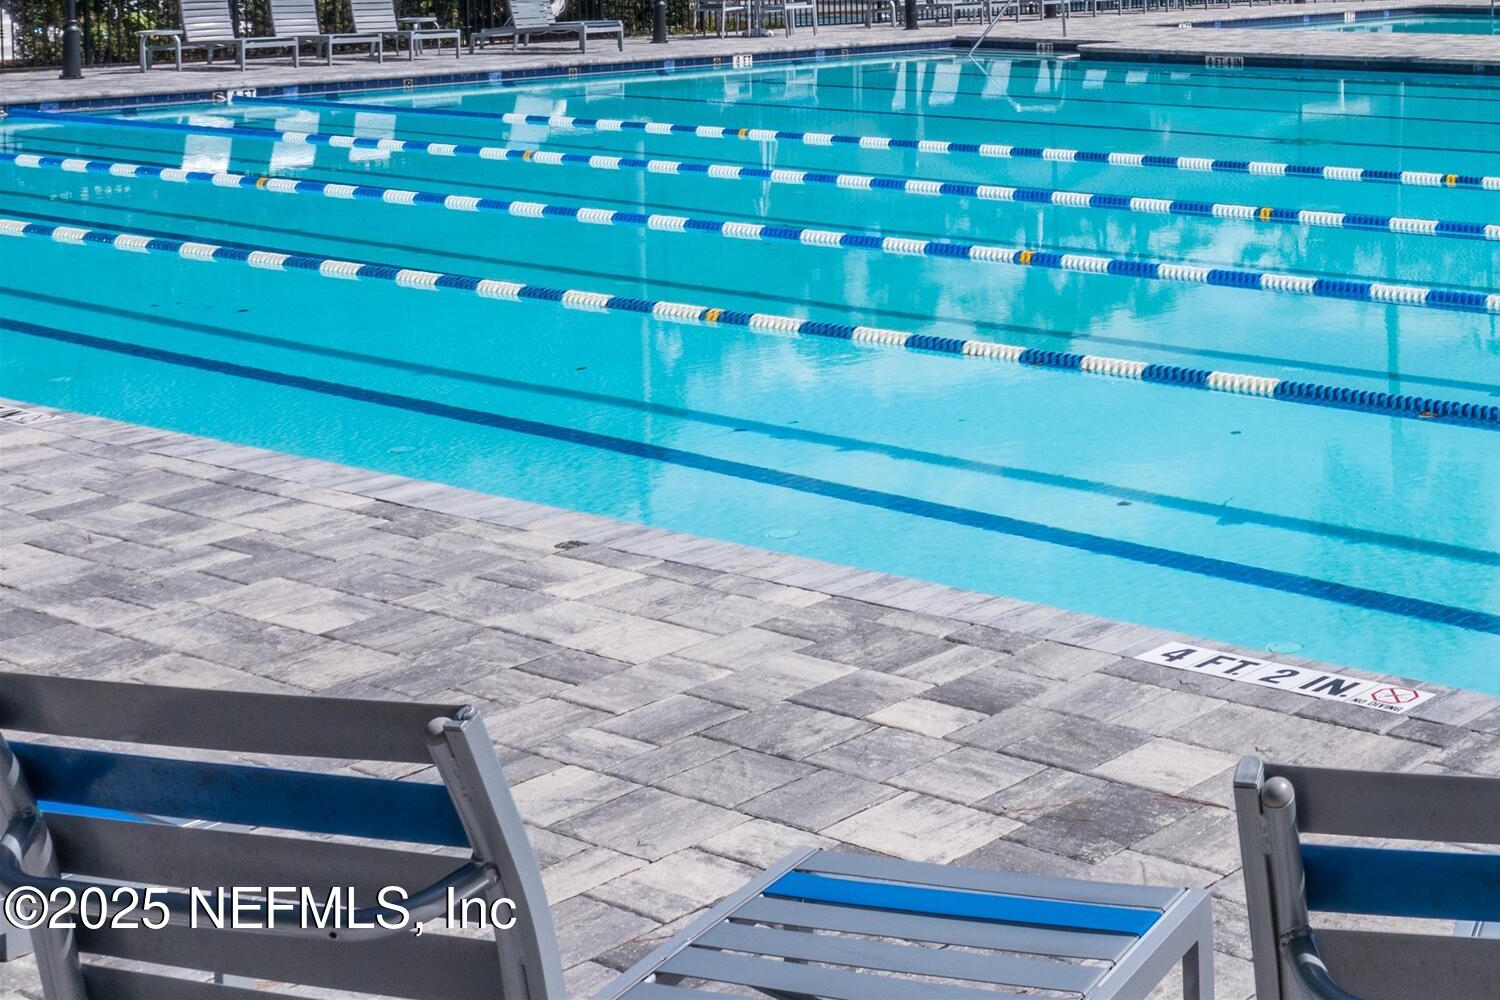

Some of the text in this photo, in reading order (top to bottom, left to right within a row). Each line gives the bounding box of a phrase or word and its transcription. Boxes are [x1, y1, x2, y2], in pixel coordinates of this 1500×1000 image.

[1161, 648, 1361, 698] 4 FT. 2 IN.
[1367, 701, 1404, 712] DIVING
